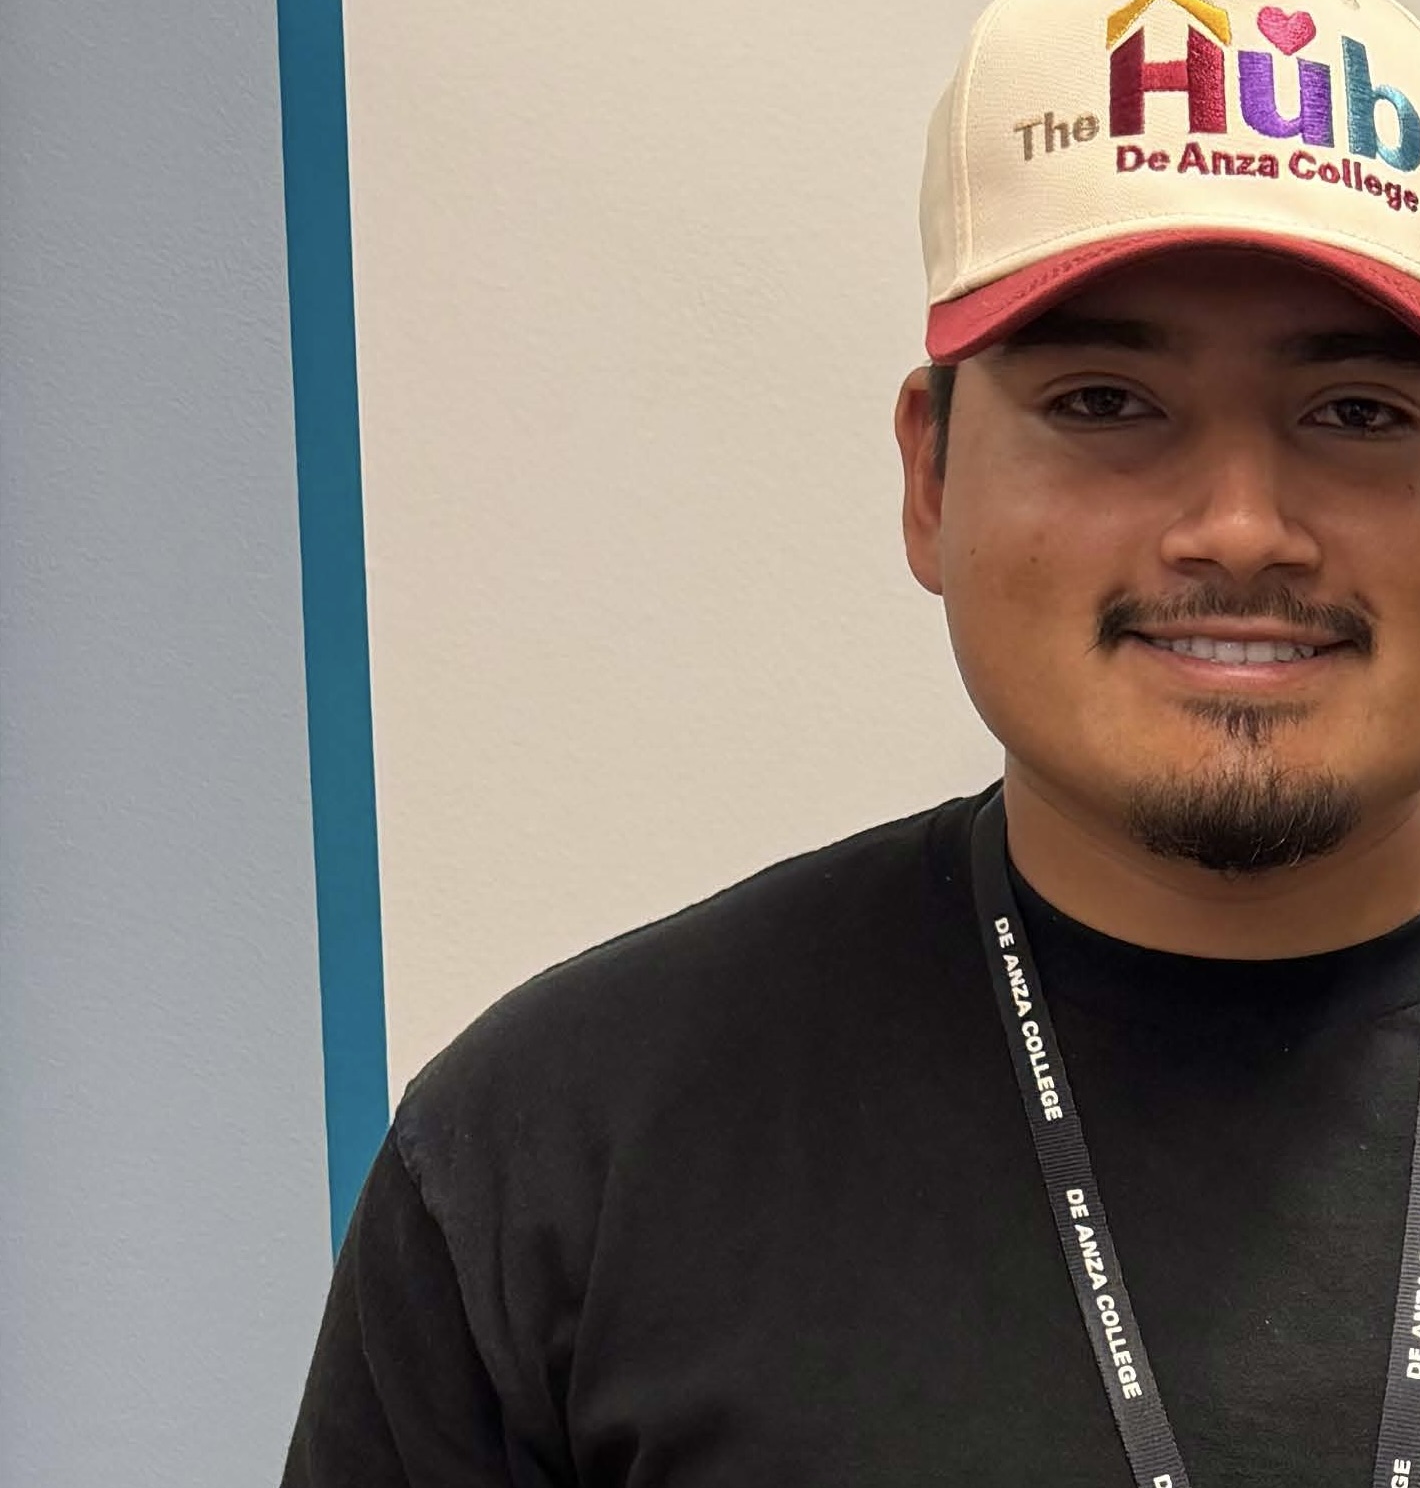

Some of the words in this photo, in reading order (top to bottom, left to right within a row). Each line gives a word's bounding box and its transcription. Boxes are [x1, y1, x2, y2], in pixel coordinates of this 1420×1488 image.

[1014, 109, 1099, 162] The
[1117, 145, 1169, 173] De
[1180, 147, 1279, 179] Anza
[1288, 151, 1419, 213] College
[994, 917, 1014, 949] DE
[1003, 954, 1029, 1017] ANZA
[1021, 1021, 1064, 1122] COLLEGE
[1066, 1188, 1090, 1219] DE
[1074, 1225, 1109, 1289] ANZA
[1096, 1293, 1142, 1400] COLLEGE
